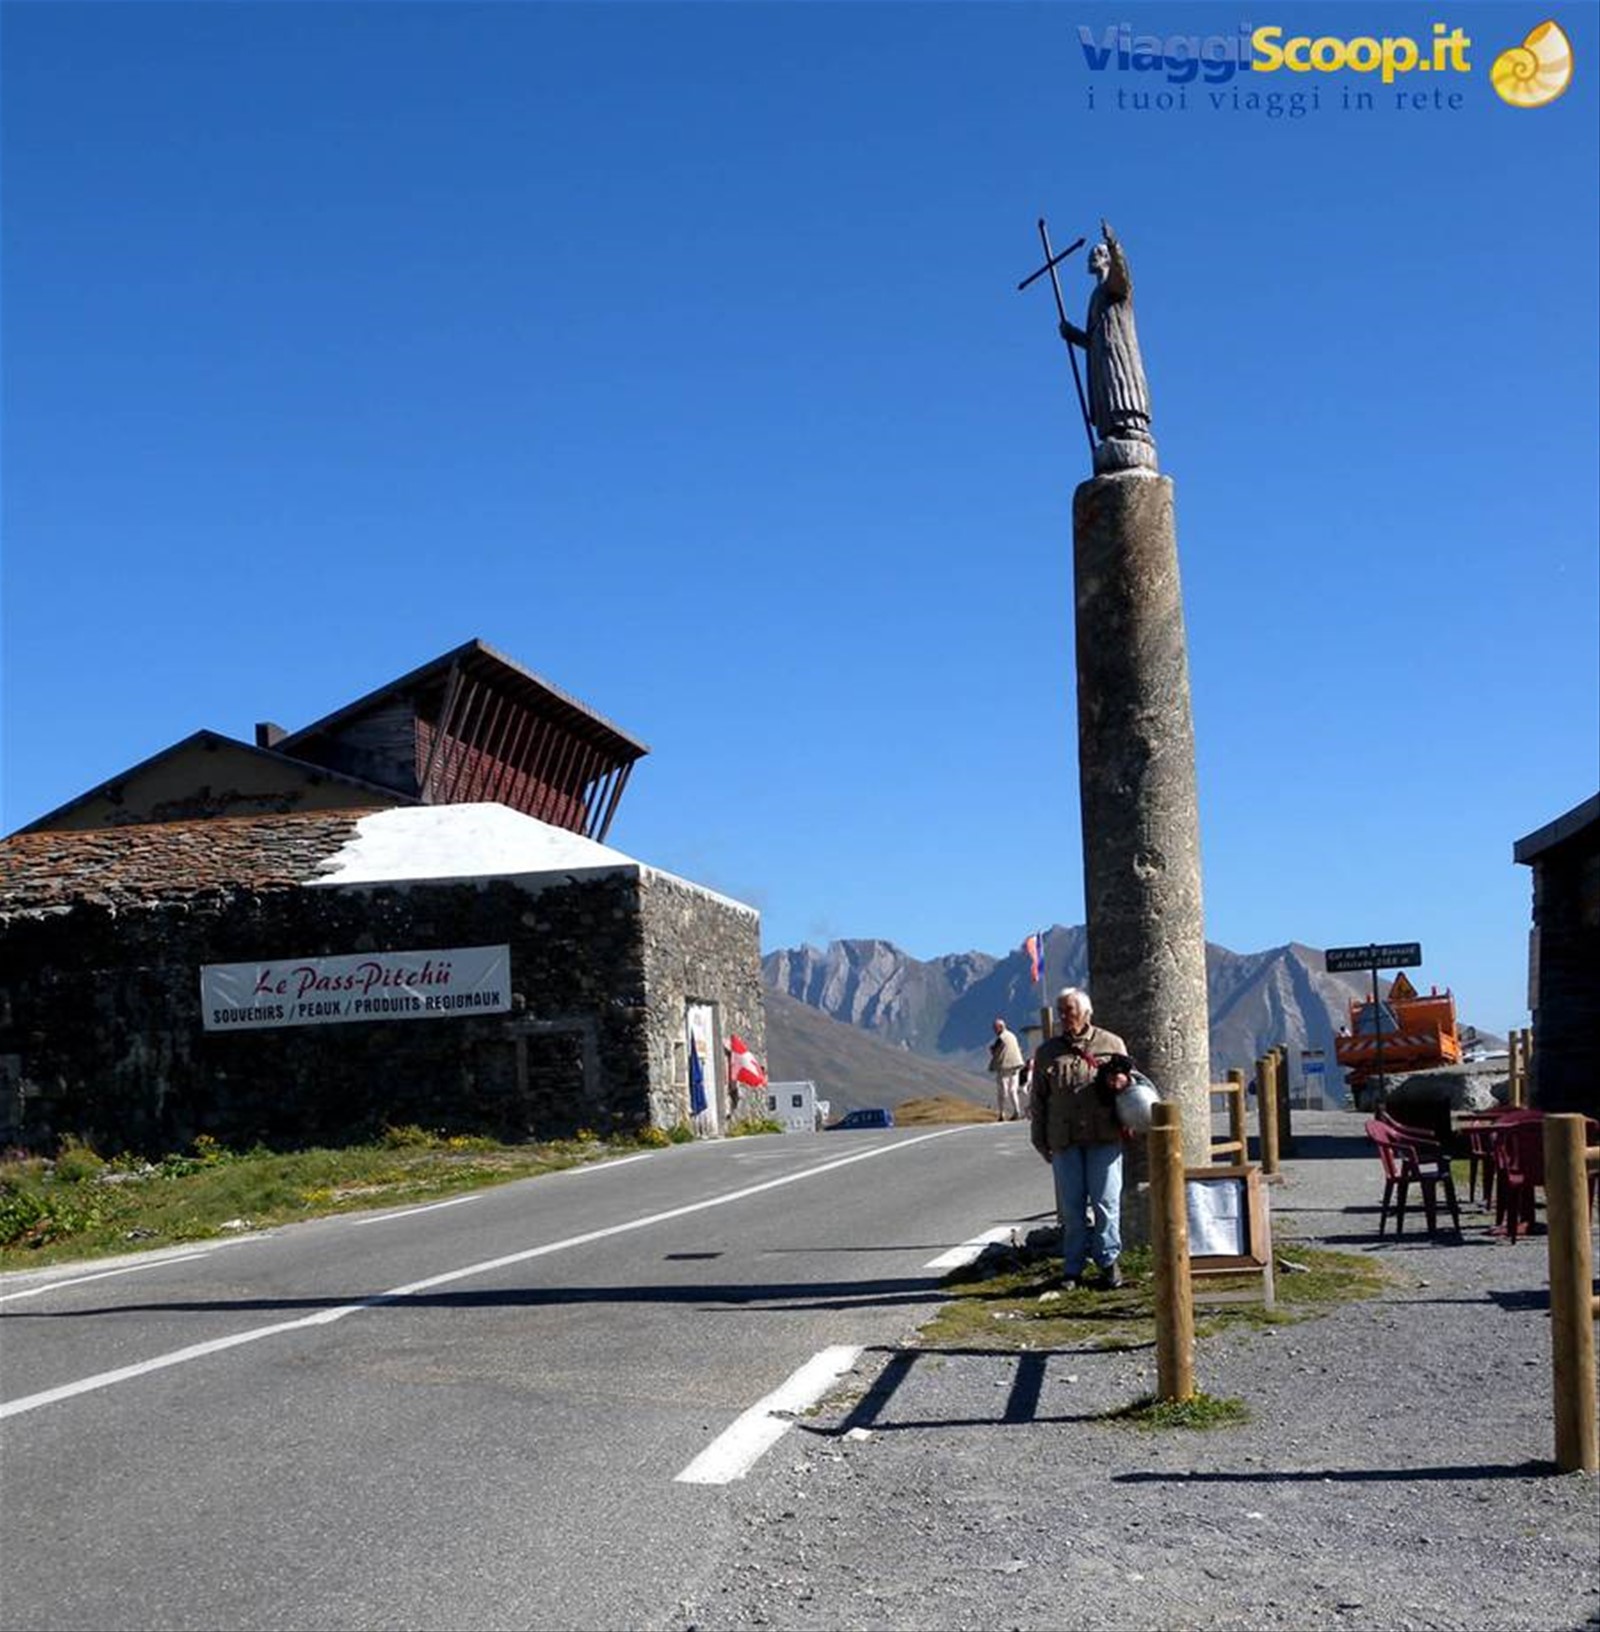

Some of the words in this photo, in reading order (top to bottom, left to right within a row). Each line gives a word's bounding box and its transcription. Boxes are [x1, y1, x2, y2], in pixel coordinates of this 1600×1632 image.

[254, 969, 286, 995] Le
[213, 1004, 284, 1024] SOUVENIRS
[299, 1001, 341, 1018] PEAUX
[354, 995, 420, 1014] PRODUITS
[425, 991, 500, 1010] REGIONAUX
